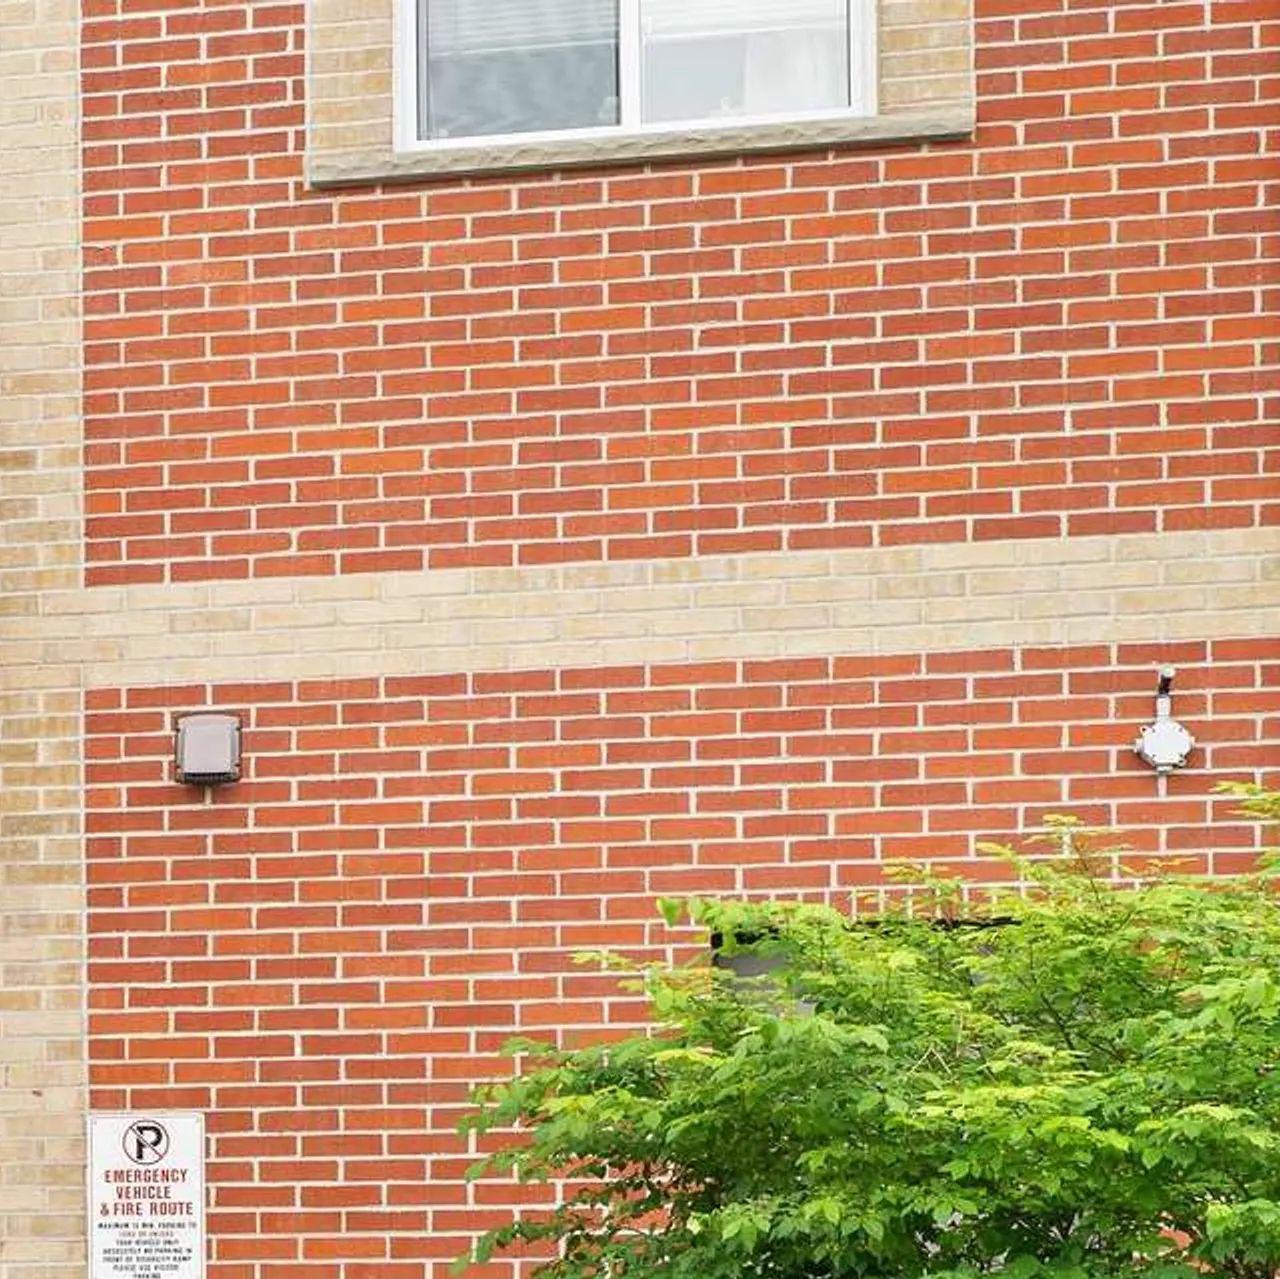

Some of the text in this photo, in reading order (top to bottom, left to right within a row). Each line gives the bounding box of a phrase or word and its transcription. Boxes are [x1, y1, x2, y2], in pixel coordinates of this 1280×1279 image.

[104, 1168, 188, 1183] EMERGENCY
[116, 1186, 171, 1199] VEHICLE
[100, 1202, 193, 1216] & FIRE ROUTE
